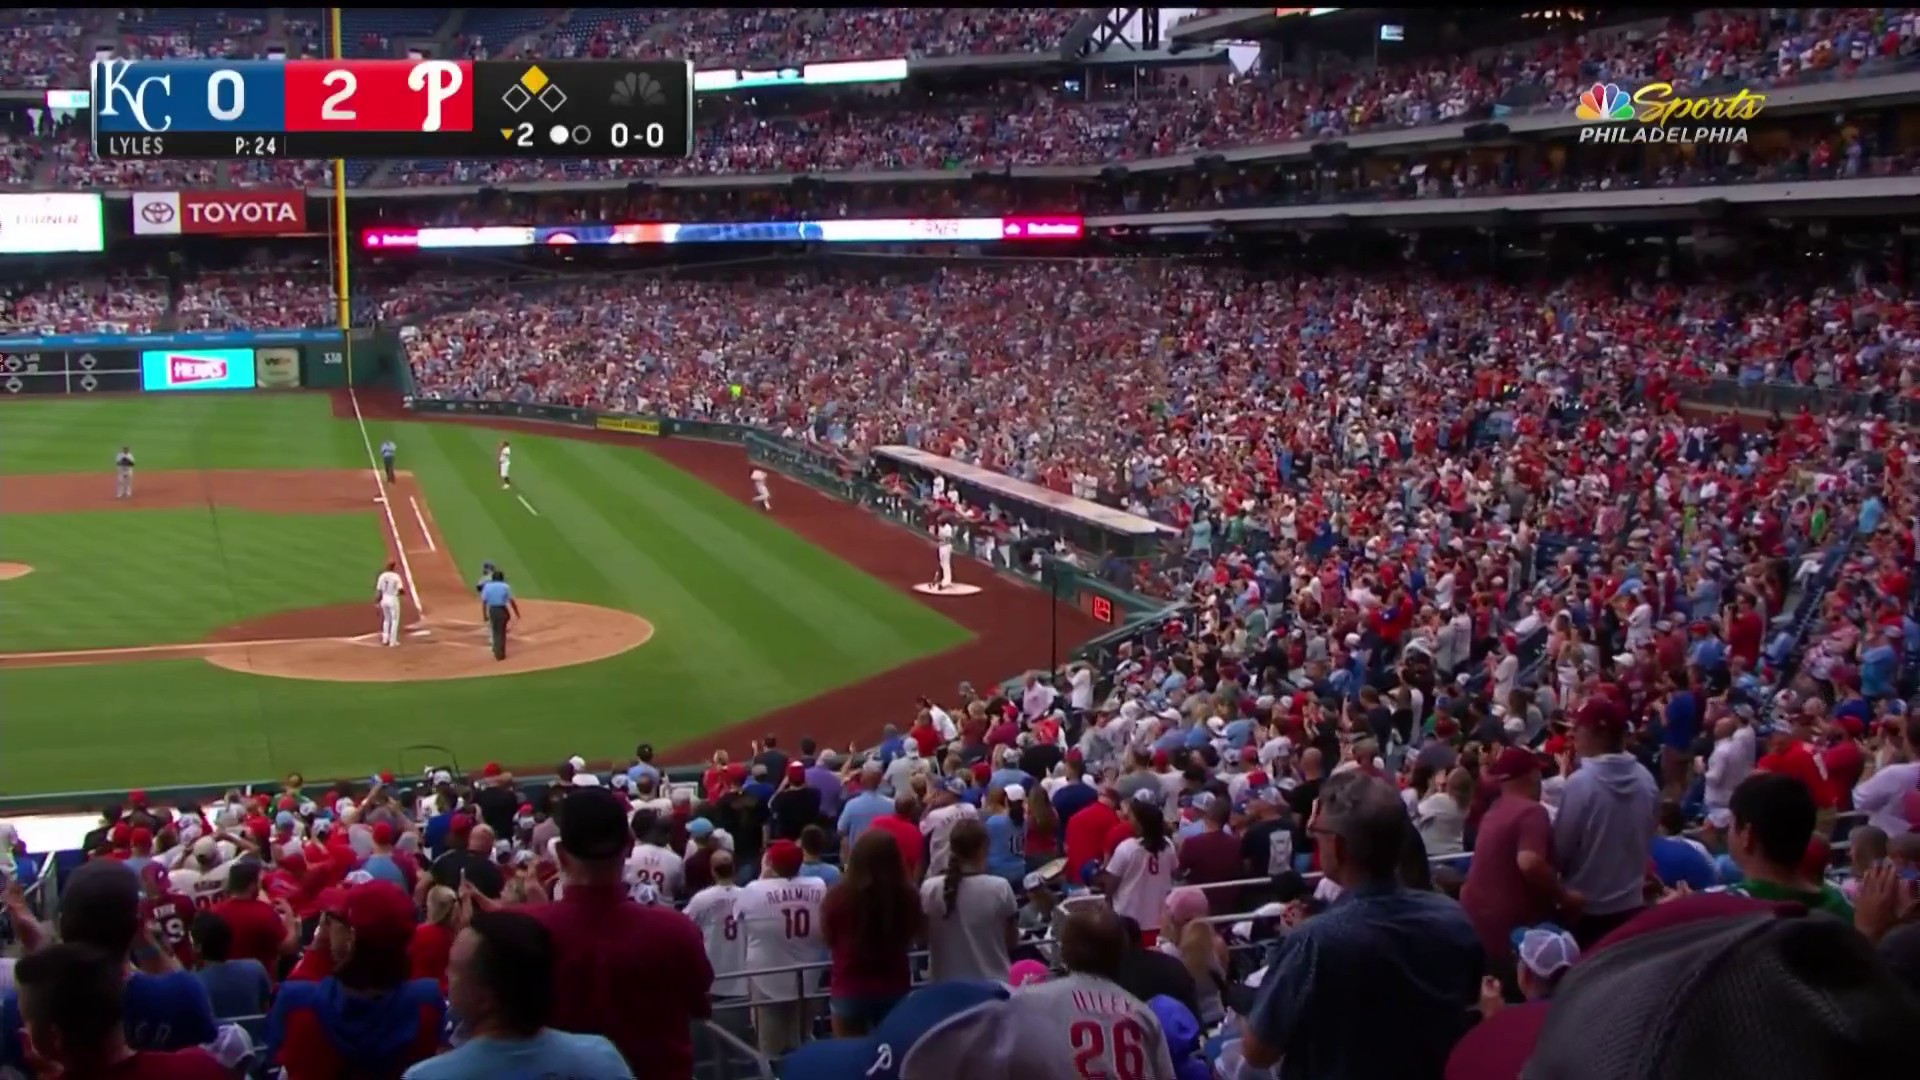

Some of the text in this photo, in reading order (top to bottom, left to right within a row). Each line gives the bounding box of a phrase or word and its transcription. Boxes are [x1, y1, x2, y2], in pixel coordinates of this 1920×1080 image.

[187, 202, 298, 223] TOYOTA
[724, 914, 738, 941] 8
[782, 908, 810, 940] 10
[1069, 1019, 1145, 1079] 26
